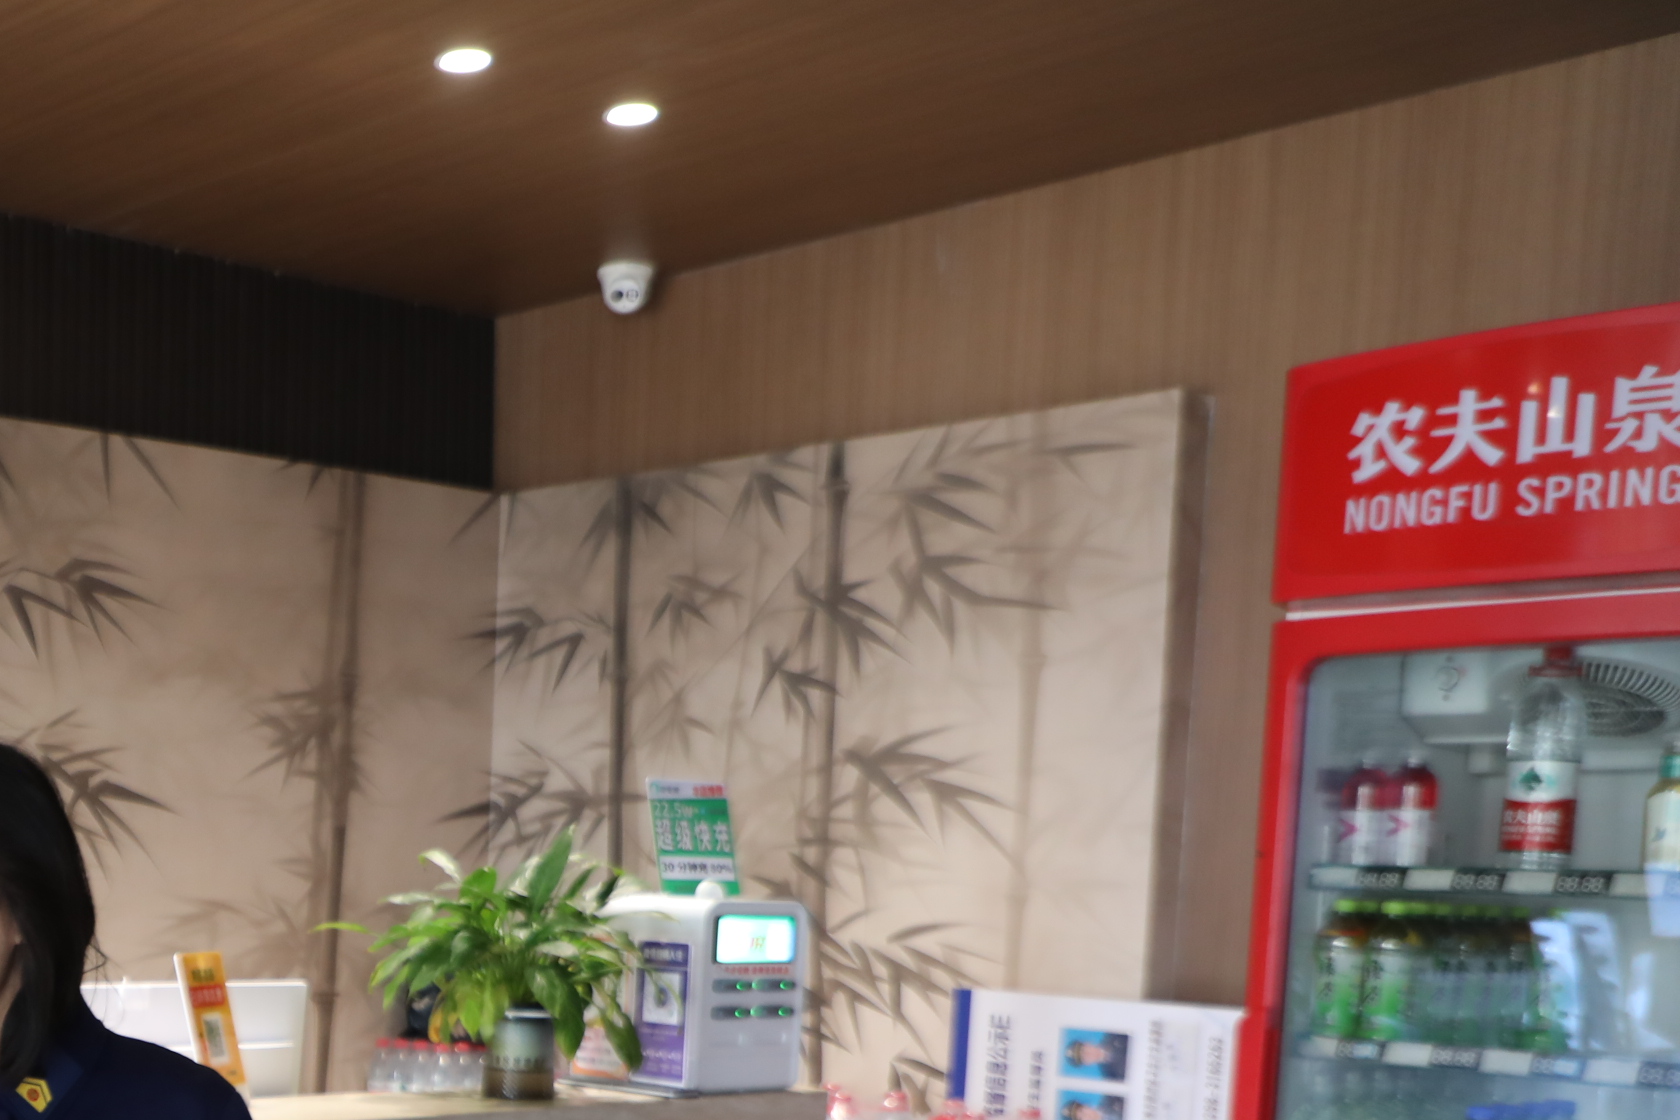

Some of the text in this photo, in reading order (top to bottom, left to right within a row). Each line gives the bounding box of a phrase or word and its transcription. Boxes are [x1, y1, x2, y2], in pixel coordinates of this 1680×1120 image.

[1346, 365, 1680, 485] 农夫山泉
[1343, 464, 1680, 535] NONGFU SPRING
[655, 819, 731, 853] 超级快充
